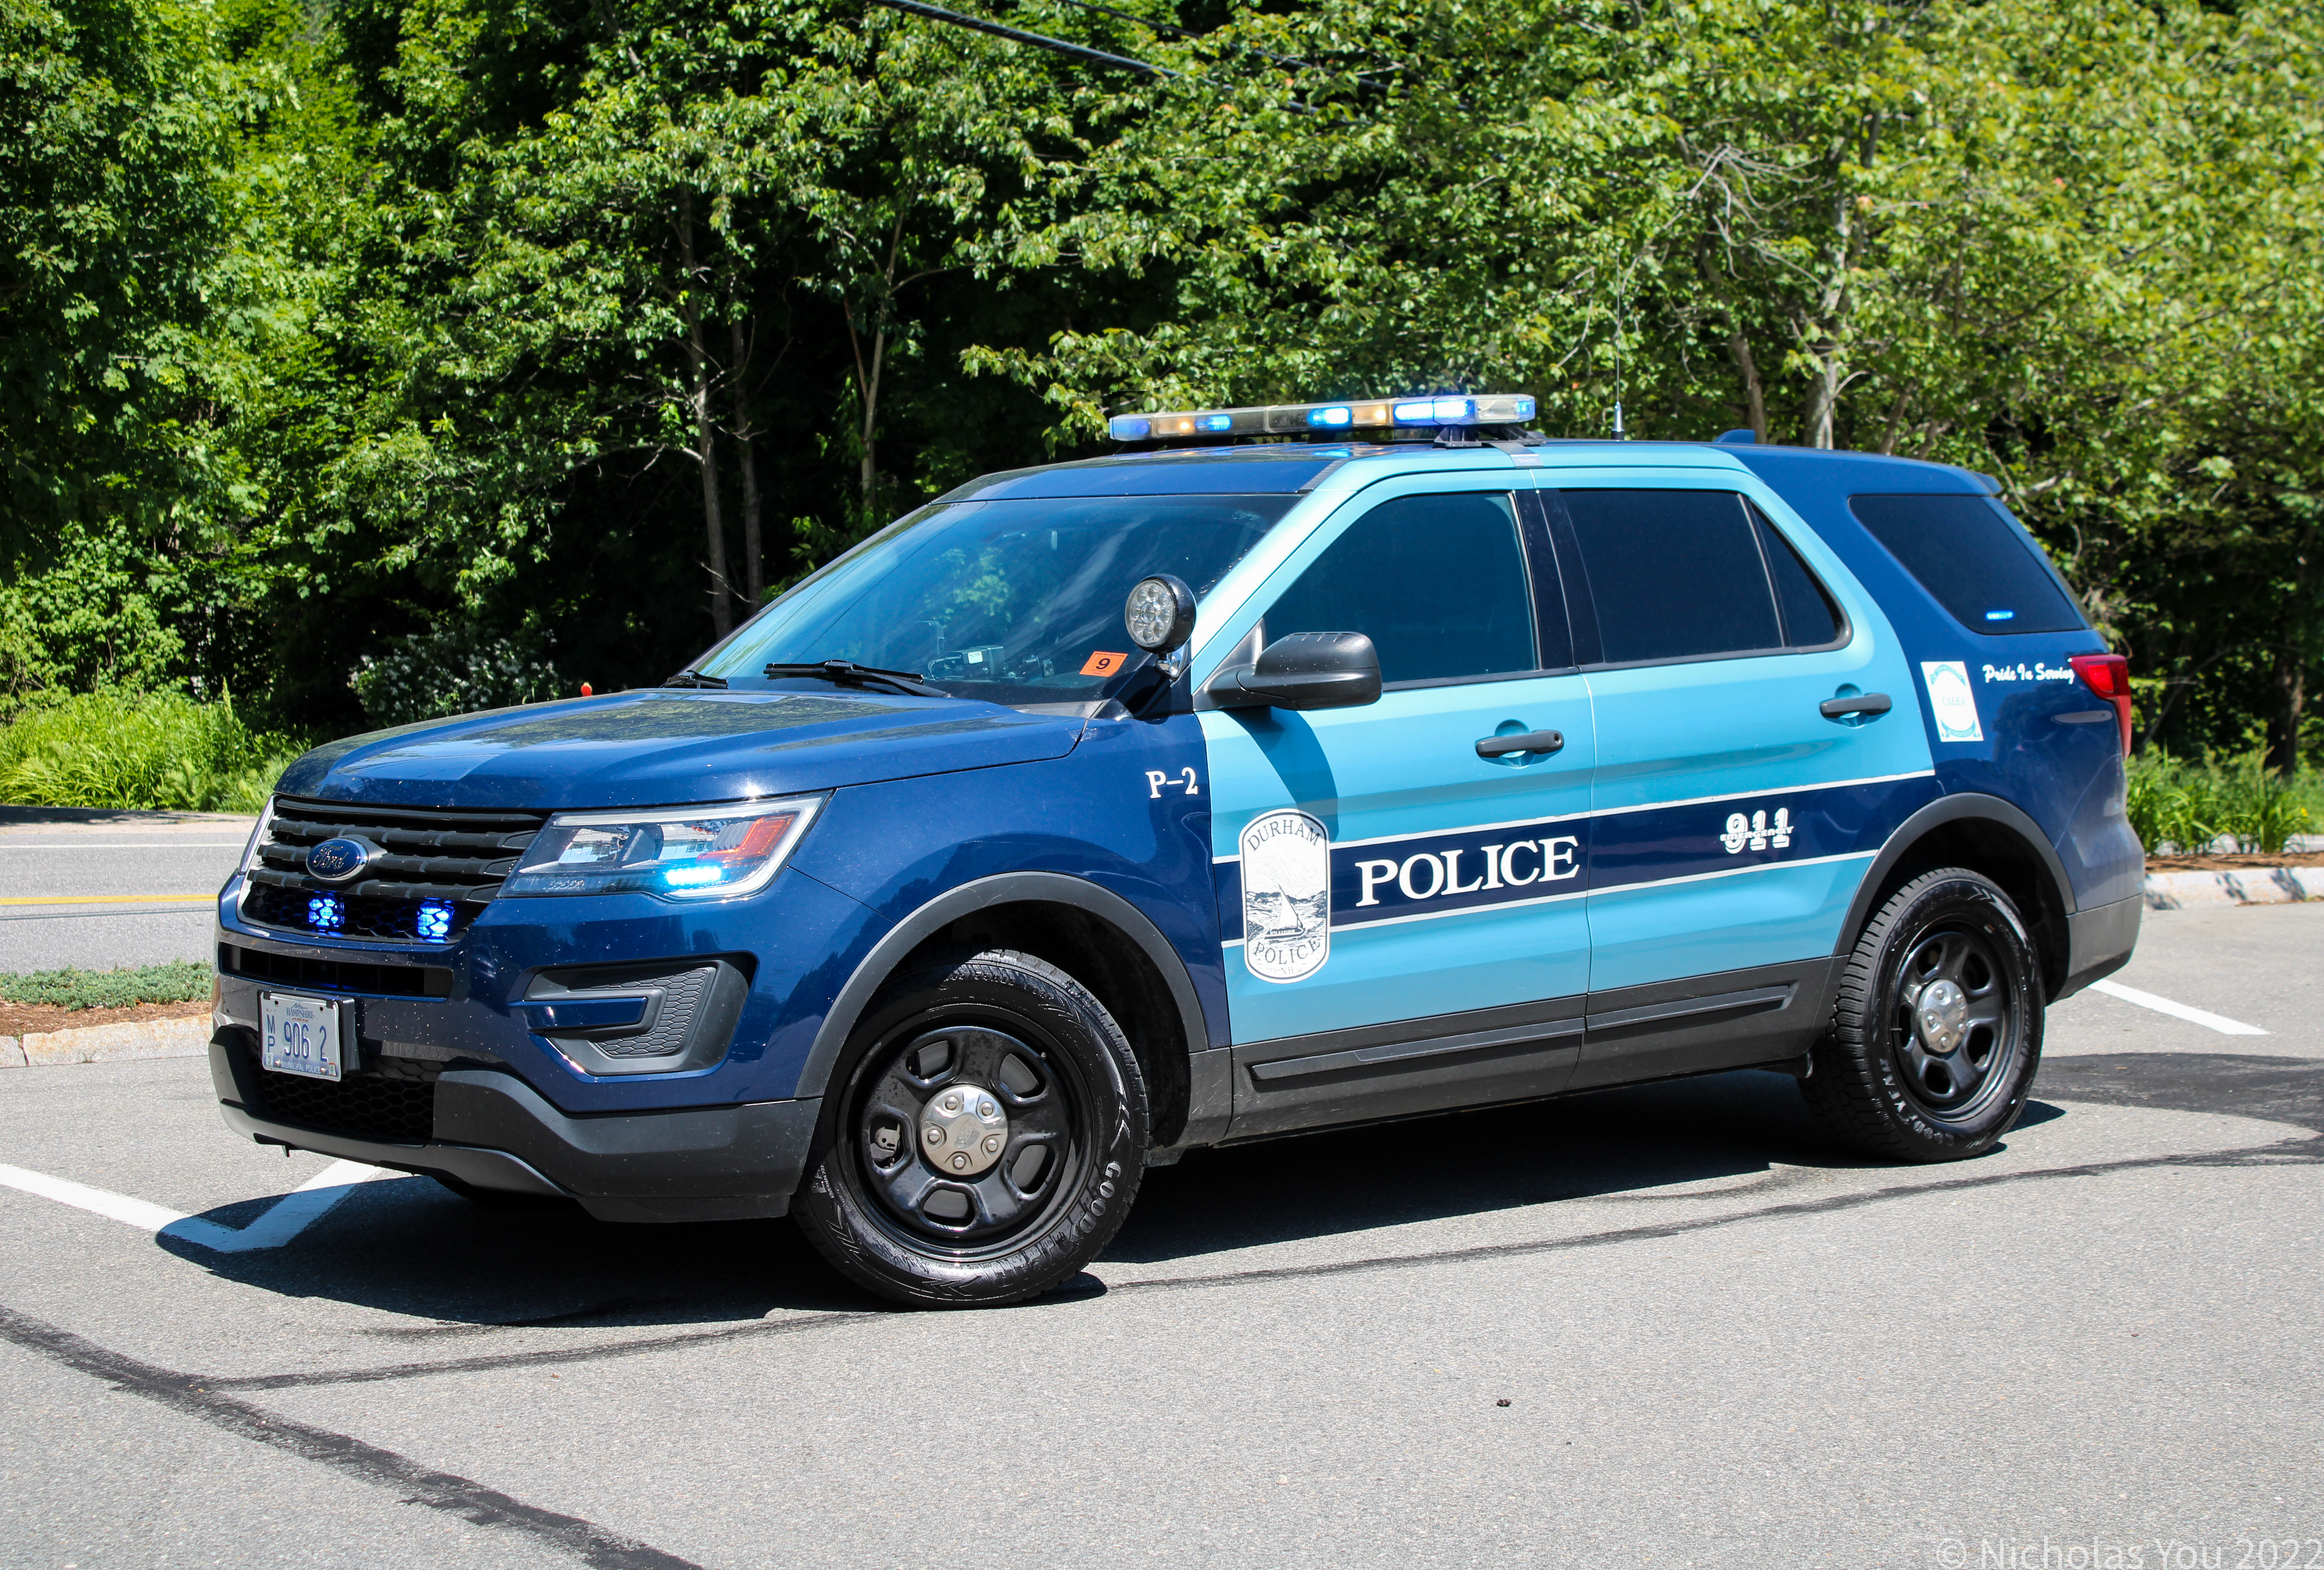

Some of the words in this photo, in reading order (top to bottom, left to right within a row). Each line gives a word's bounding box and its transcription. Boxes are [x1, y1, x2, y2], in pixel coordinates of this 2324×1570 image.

[1096, 658, 1110, 670] 9
[1982, 664, 2017, 683] Pride
[2017, 663, 2034, 681] In
[2035, 663, 2075, 685] Serving
[1942, 697, 1966, 706] CALEA
[1145, 767, 1198, 799] P-2
[1247, 820, 1321, 852] DURHAM
[1725, 807, 1790, 854] 911
[313, 844, 349, 869] Ford
[1355, 835, 1580, 907] POLICE
[1253, 936, 1321, 965] POLICE
[1281, 966, 1294, 975] NH
[286, 1007, 314, 1019] HAMPSHIRE
[284, 1021, 311, 1059] 906
[320, 1026, 328, 1062] 2
[268, 1056, 272, 1064] 3
[281, 1061, 305, 1072] MUNICIPAL
[305, 1064, 321, 1074] POLICE
